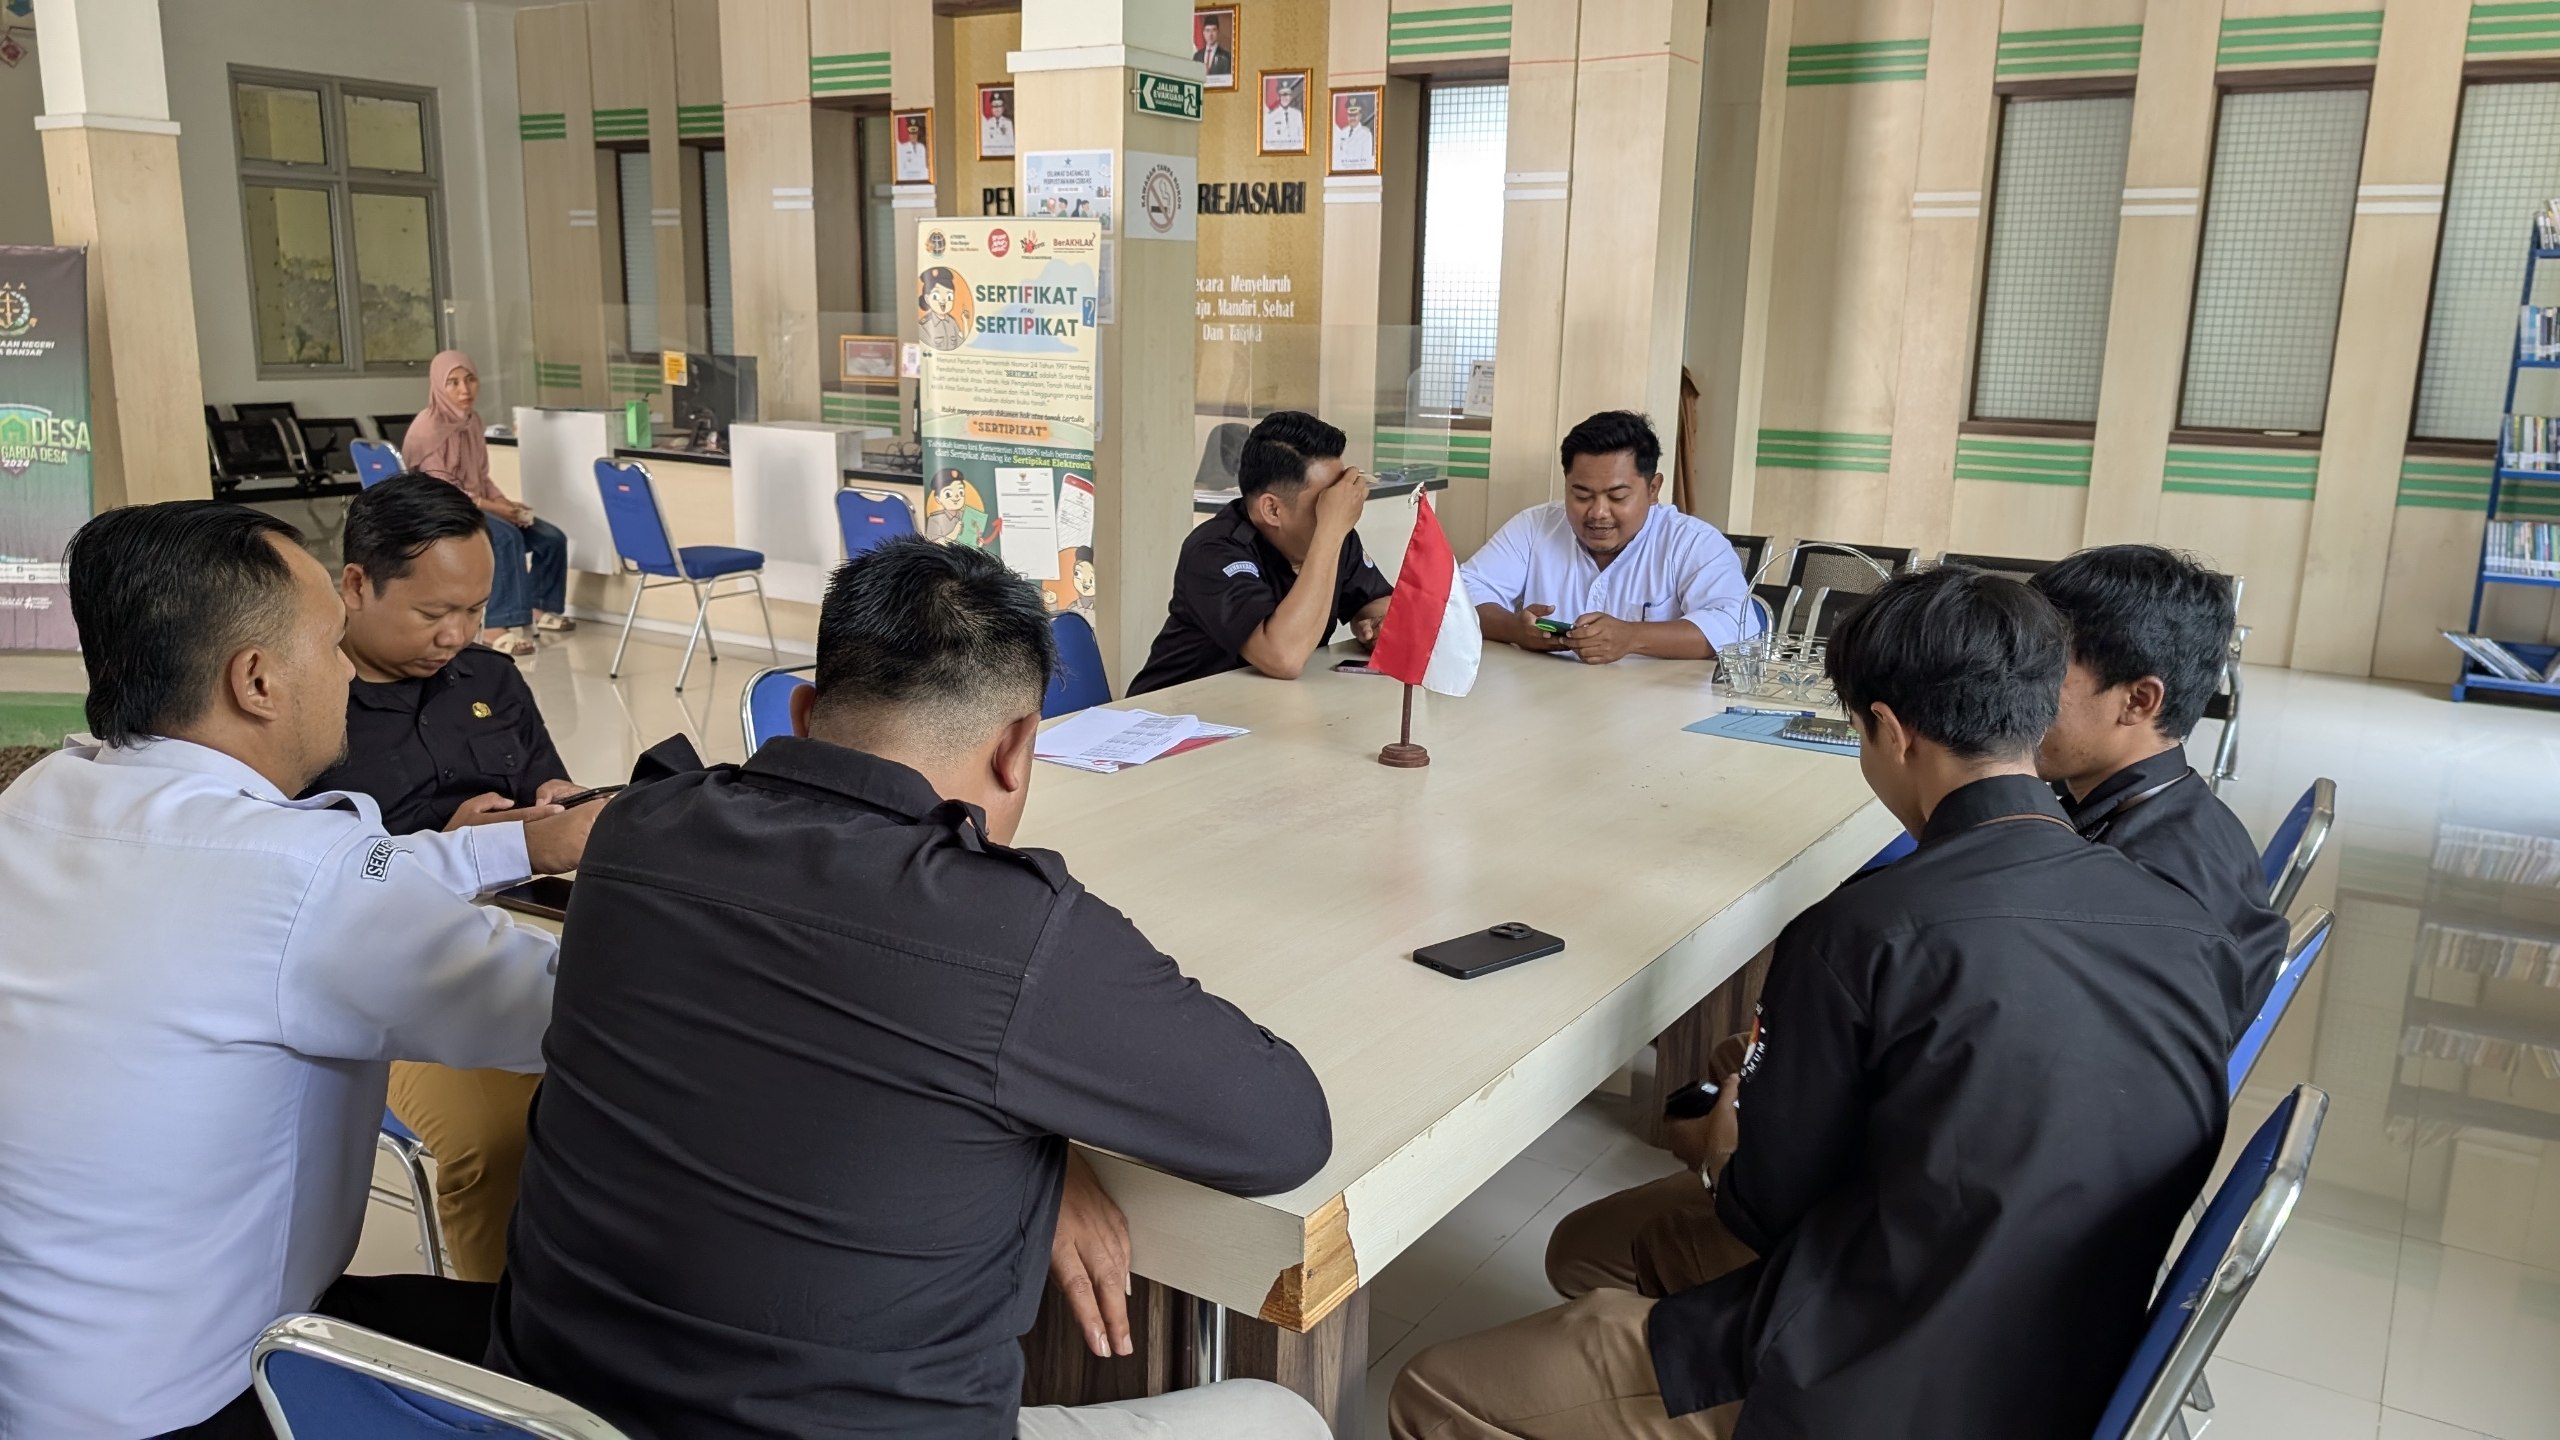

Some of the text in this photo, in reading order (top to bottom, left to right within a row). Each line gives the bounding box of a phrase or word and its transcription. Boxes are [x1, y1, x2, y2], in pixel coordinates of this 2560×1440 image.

[1153, 89, 1184, 102] EVAKUASI
[1157, 82, 1179, 94] JALUR
[1053, 238, 1094, 247] BerAKHLAK
[1231, 274, 1292, 296] Menyeluruh
[975, 284, 1078, 306] SERTIFIKAT
[1262, 300, 1294, 318] Sehat
[975, 315, 1079, 337] SERTIPIKAT
[1203, 324, 1224, 341] Dan
[5, 348, 43, 357] BANJAR
[21, 341, 55, 350] NEGERI
[31, 417, 91, 452] DESA
[40, 446, 68, 464] DESA
[1013, 455, 1051, 467] Sertipikat
[1052, 459, 1093, 470] Elektronik
[3, 459, 31, 468] 2024
